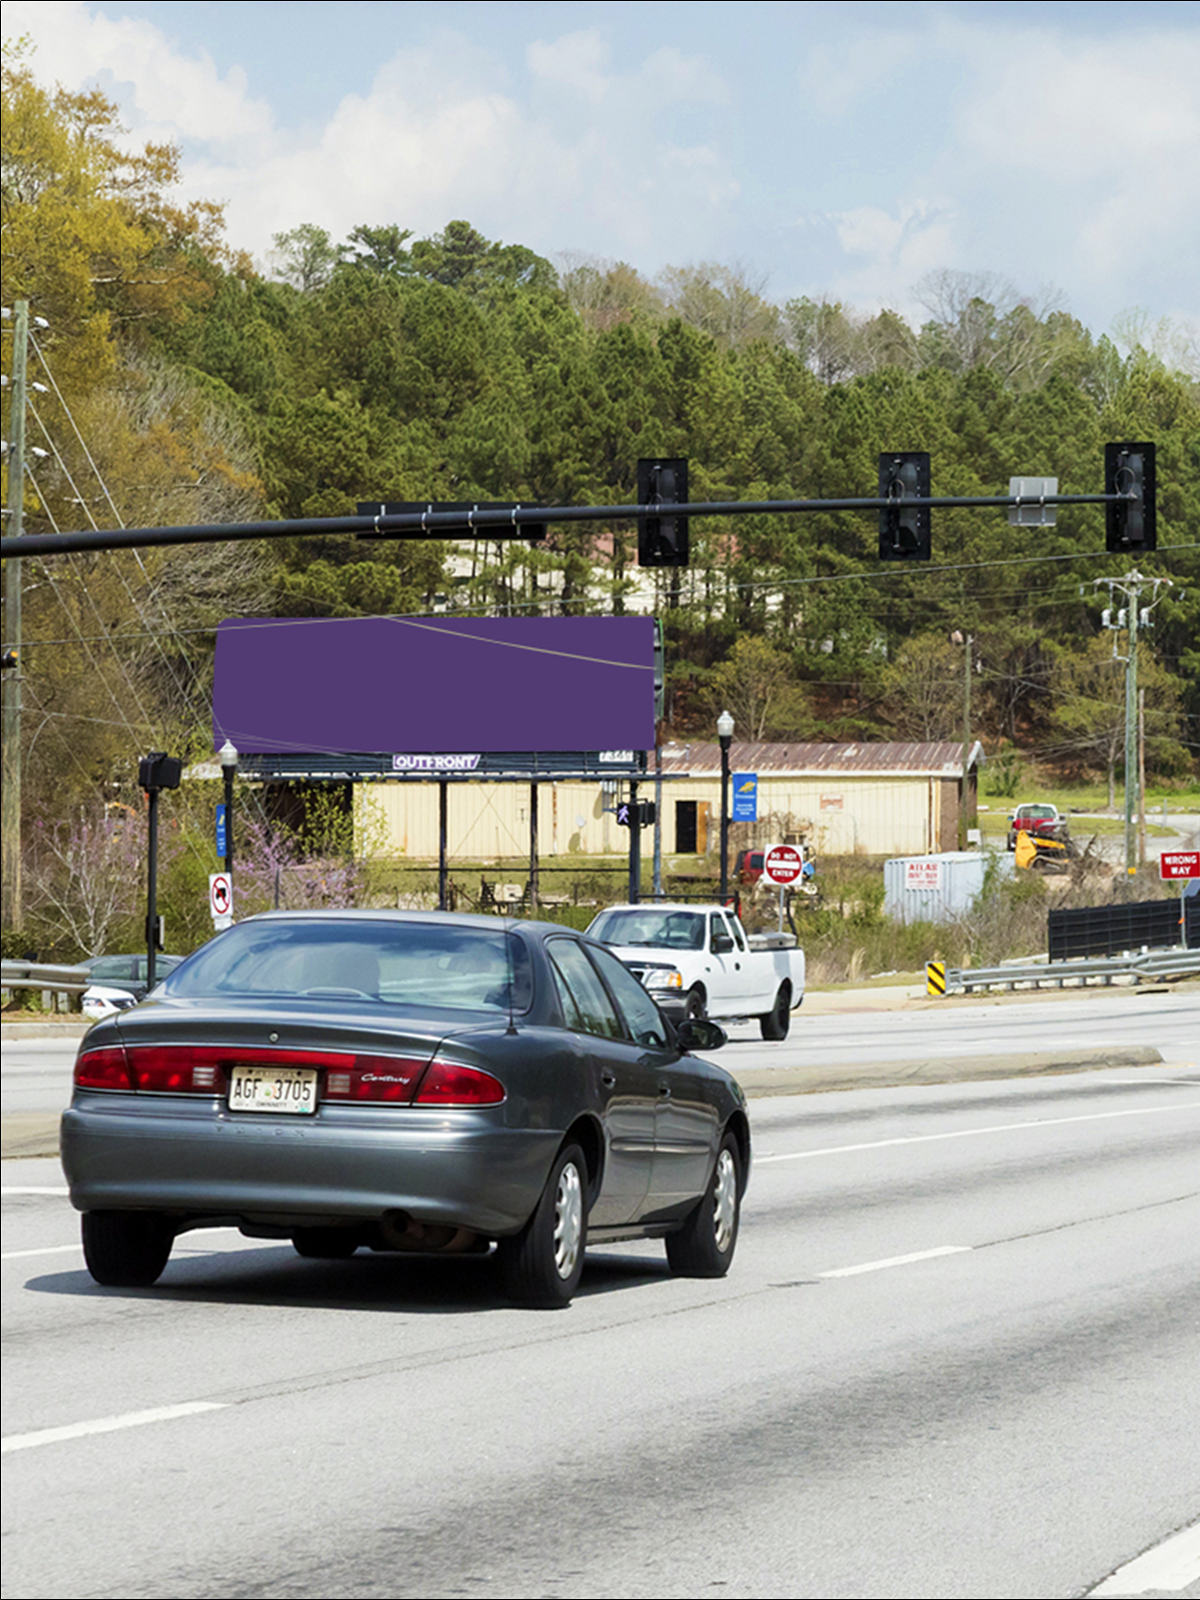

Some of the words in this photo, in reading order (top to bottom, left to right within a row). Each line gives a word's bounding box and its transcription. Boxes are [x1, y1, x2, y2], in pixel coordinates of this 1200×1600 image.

[396, 755, 476, 768] OUTFRONT
[770, 851, 781, 860] DO
[1164, 855, 1198, 865] WRONG
[908, 863, 938, 871] ATLAS
[1171, 866, 1191, 875] WAY
[772, 869, 794, 878] ENTER
[361, 1073, 410, 1085] Century
[234, 1078, 262, 1100] AGF
[274, 1079, 312, 1101] 3705
